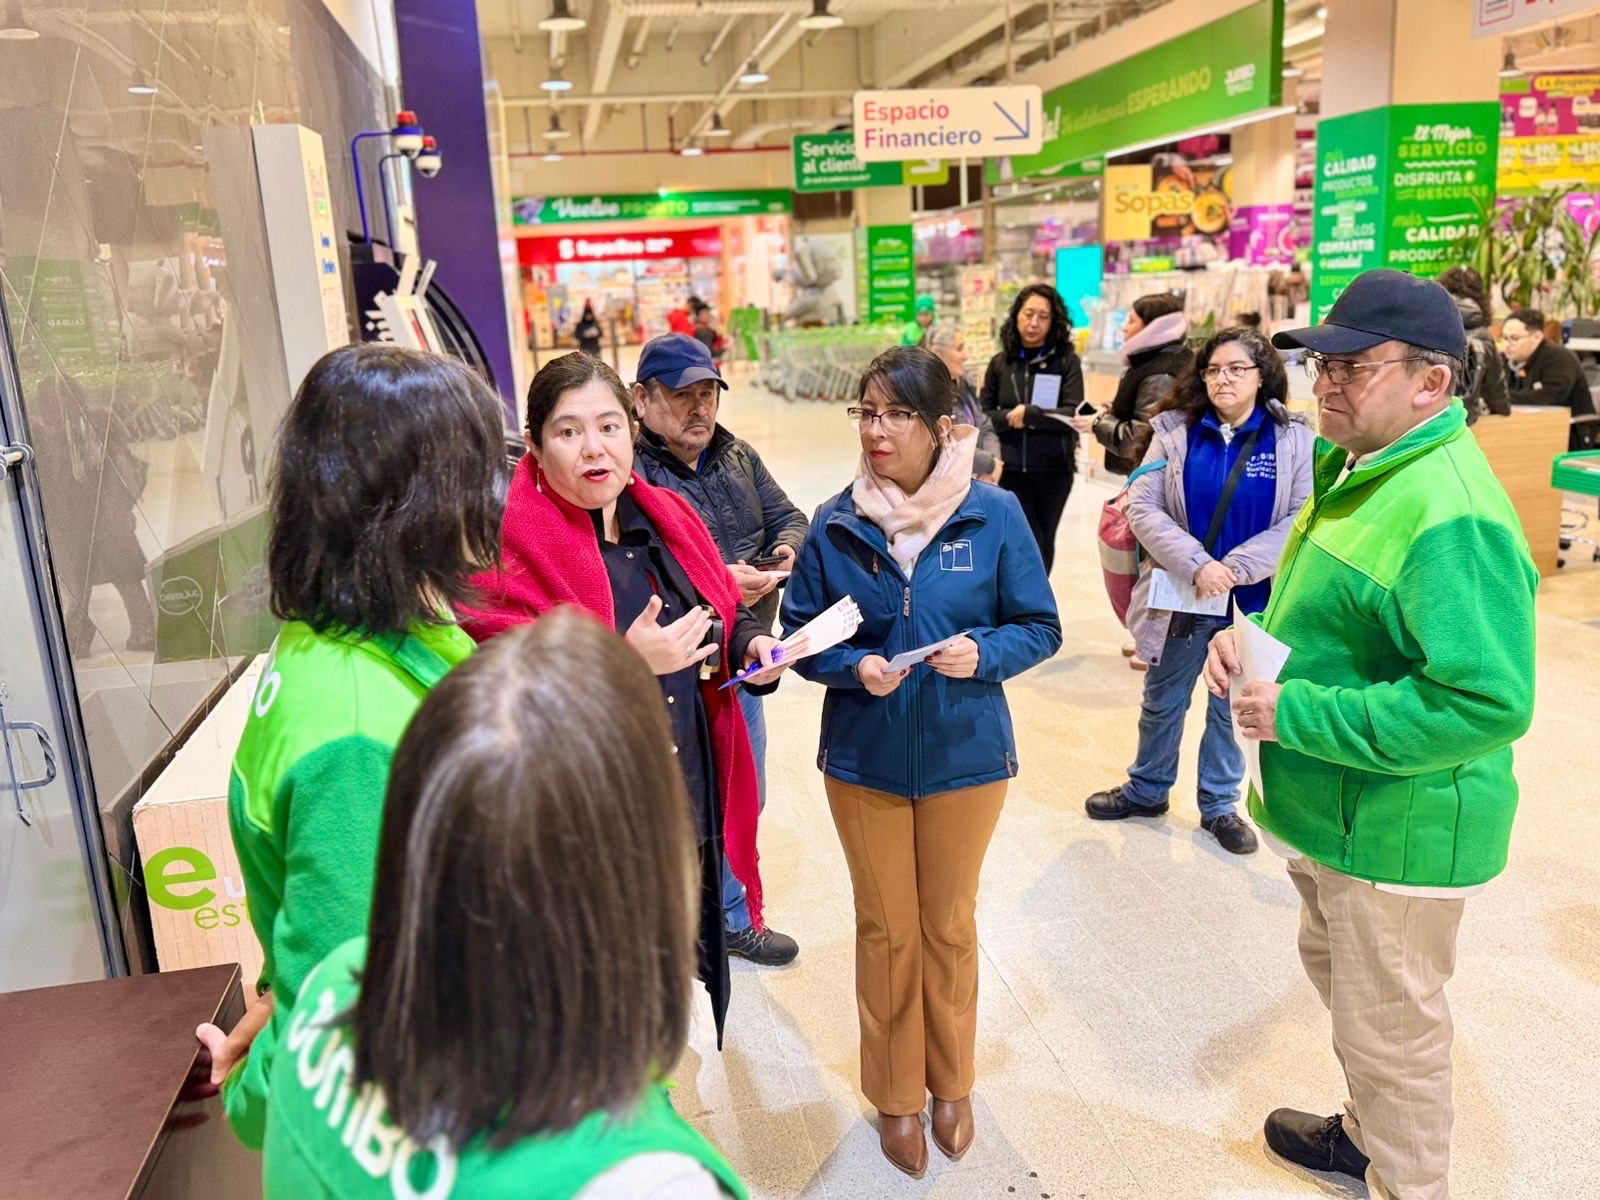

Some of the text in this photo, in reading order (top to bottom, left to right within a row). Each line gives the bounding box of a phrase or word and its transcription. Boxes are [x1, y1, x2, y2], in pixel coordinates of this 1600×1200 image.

[1127, 66, 1212, 114] ESPERANDO
[864, 99, 950, 125] Espacio
[865, 126, 981, 148] Financiero
[1398, 141, 1487, 158] SERVICIO
[802, 158, 817, 174] al
[1324, 155, 1377, 177] CALIDAD
[1394, 171, 1462, 187] DISFRUTA
[1115, 191, 1192, 217] Sopas
